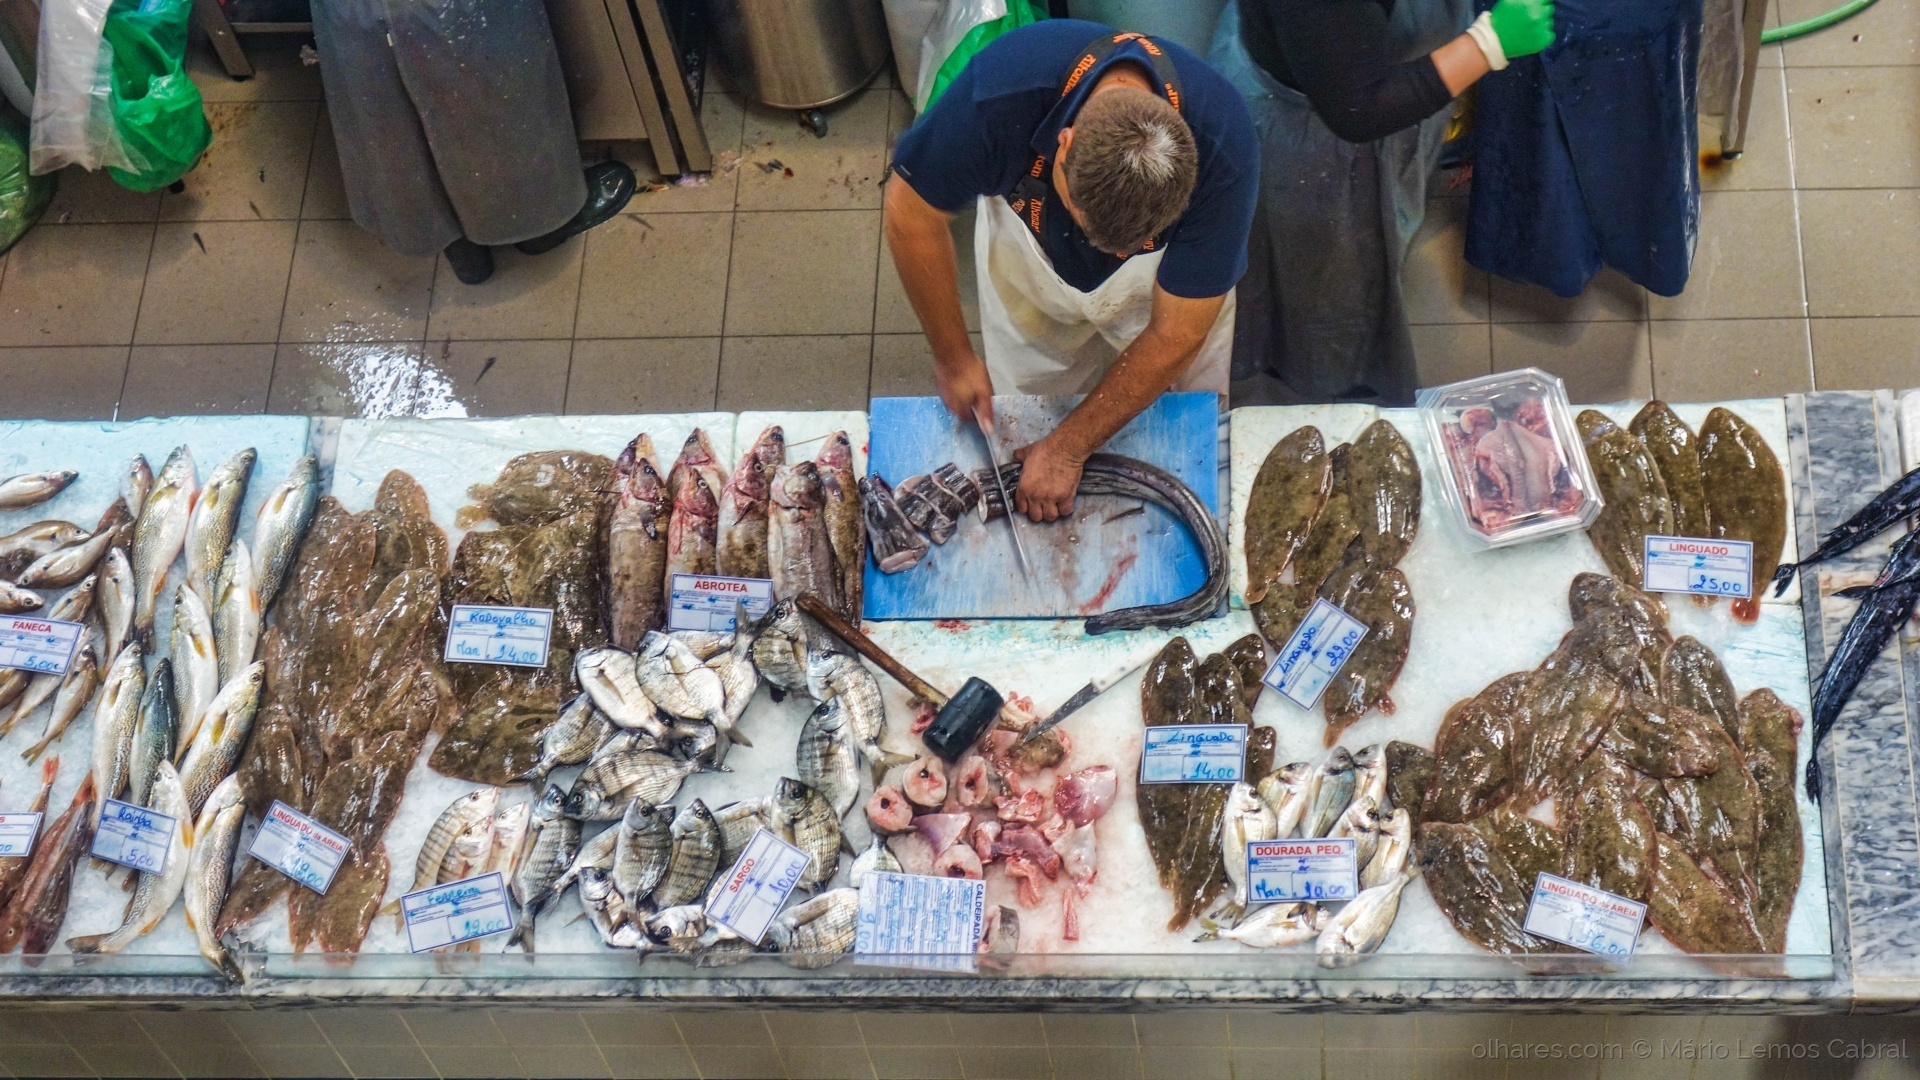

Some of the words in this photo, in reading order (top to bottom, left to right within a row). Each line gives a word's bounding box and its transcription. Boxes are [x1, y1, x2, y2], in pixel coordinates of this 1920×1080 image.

[1669, 543, 1729, 556] LINGUADO
[694, 580, 748, 593] ABROTEA
[1692, 574, 1742, 593] 25,00
[12, 620, 52, 633] FANECA
[1190, 762, 1236, 780] 14,00
[272, 808, 313, 835] LINGUADO
[321, 836, 344, 852] AREIA
[1256, 846, 1312, 856] DOURADA
[729, 858, 756, 893] SARGO
[1541, 880, 1598, 905] LINGUADO
[1610, 904, 1638, 918] AREIA
[972, 883, 984, 940] CALDEIRADA
